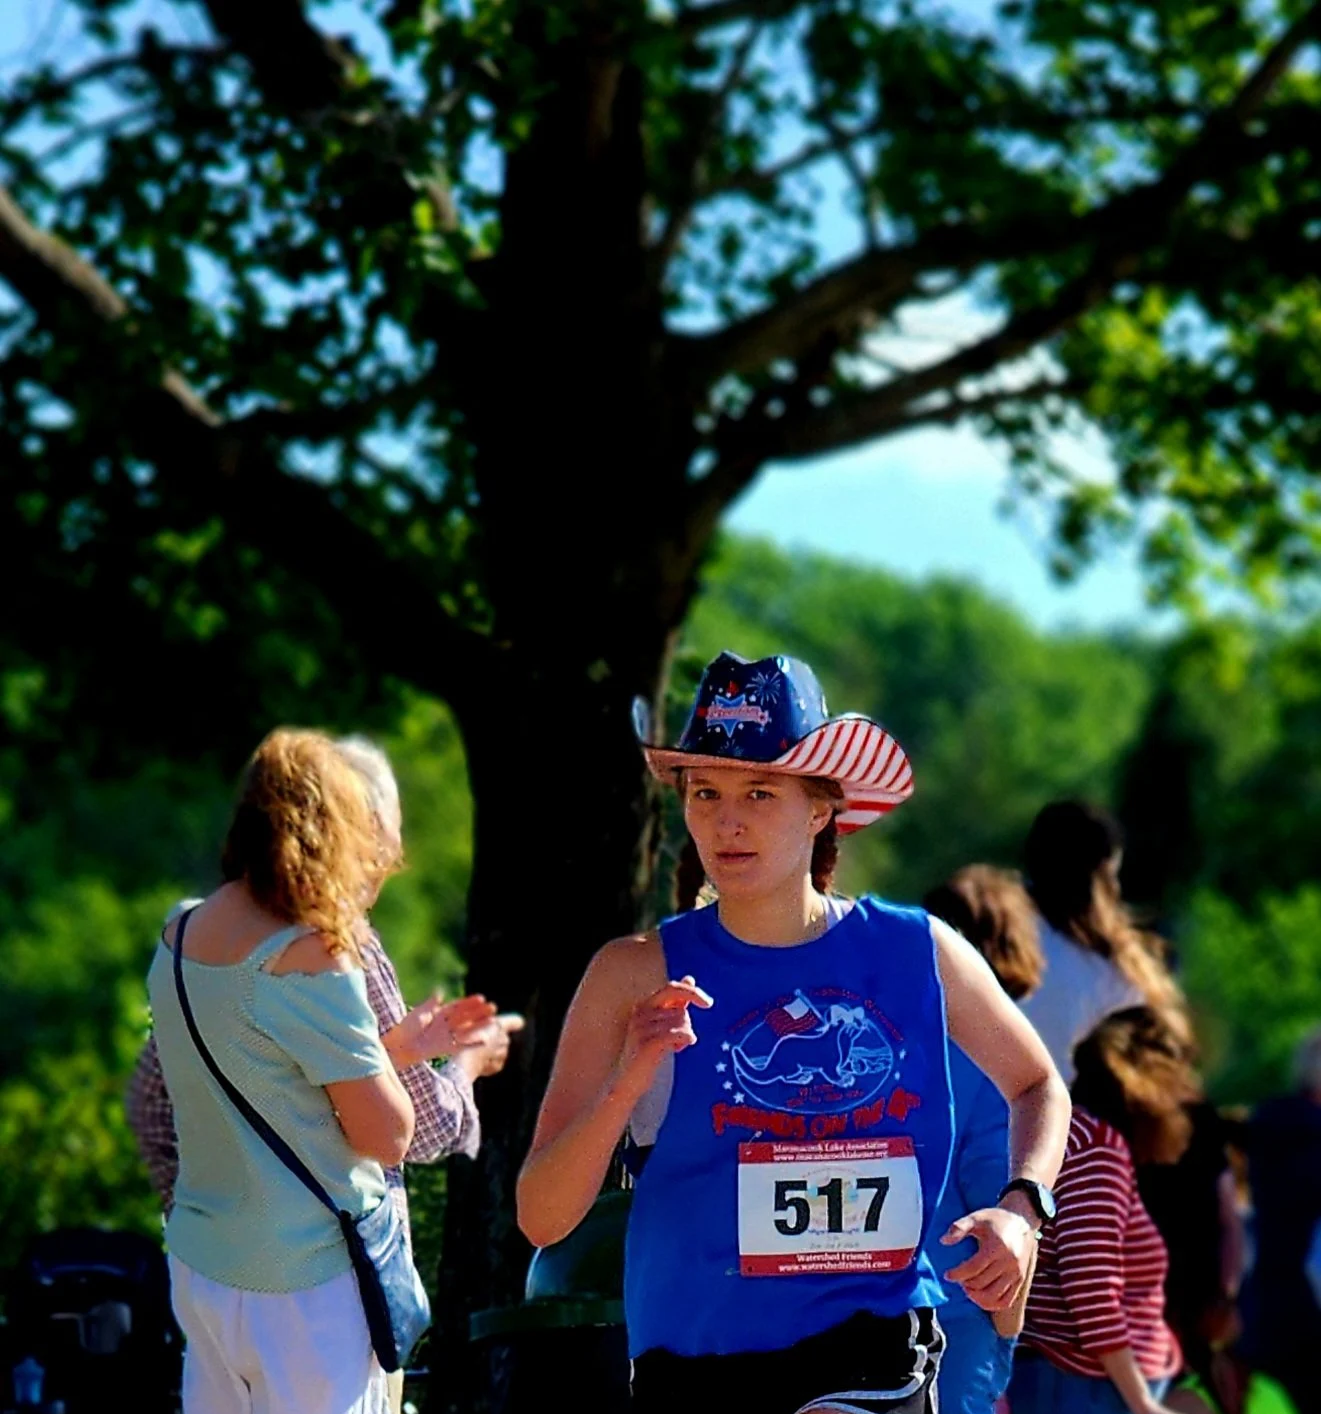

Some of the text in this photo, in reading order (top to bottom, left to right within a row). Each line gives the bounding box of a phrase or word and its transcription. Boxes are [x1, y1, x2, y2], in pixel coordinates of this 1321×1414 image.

[810, 1113, 848, 1138] ON
[825, 1142, 844, 1152] Lake
[774, 1176, 889, 1236] 517
[796, 1252, 872, 1262] Watershed Friends
[778, 1261, 891, 1273] www.watershedfriends.com
